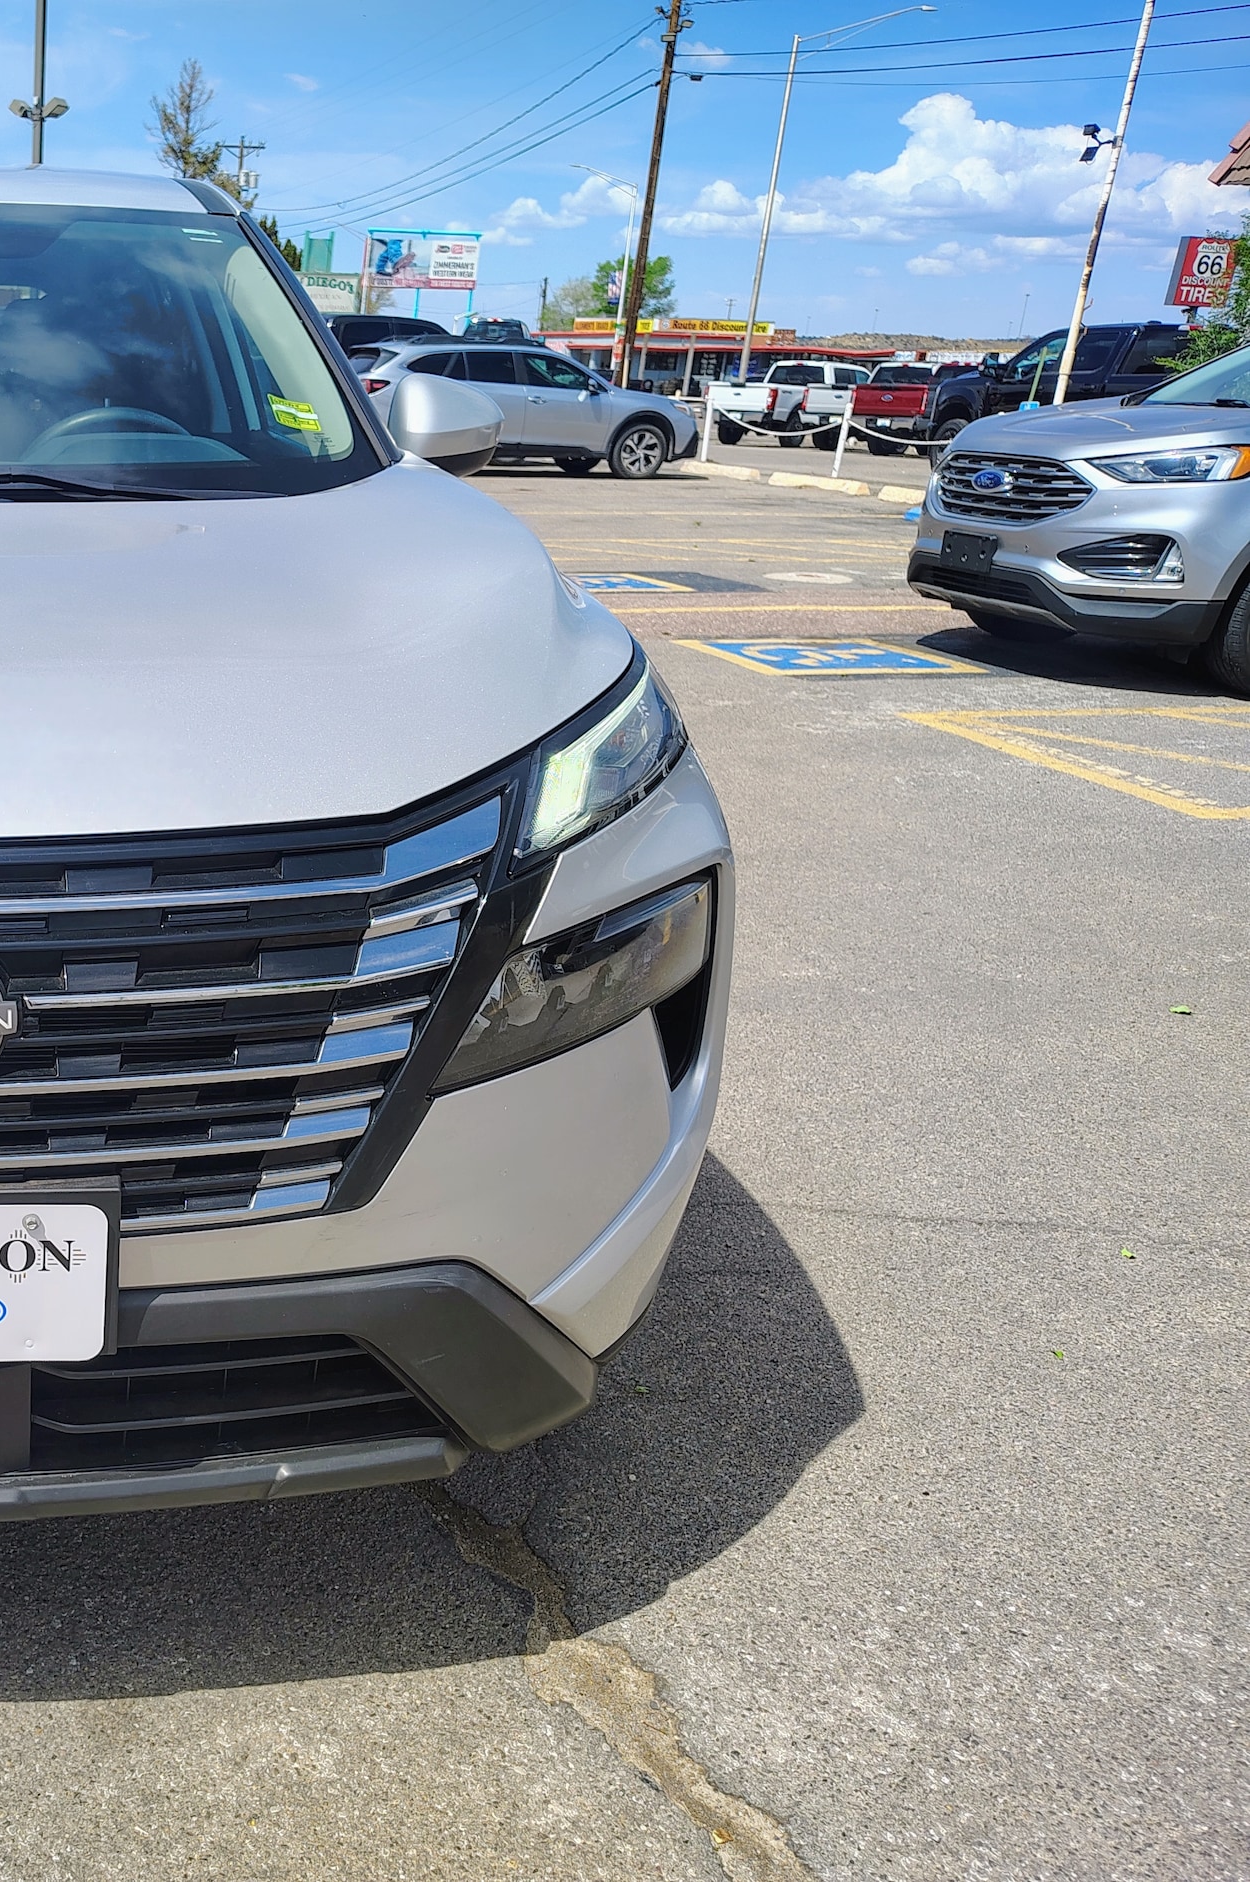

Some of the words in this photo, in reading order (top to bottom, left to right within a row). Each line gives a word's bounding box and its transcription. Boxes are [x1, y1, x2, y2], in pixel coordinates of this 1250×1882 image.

[1197, 255, 1224, 275] 66
[1182, 275, 1229, 286] DISCOUNT
[672, 320, 696, 330] Route
[699, 320, 710, 330] 66
